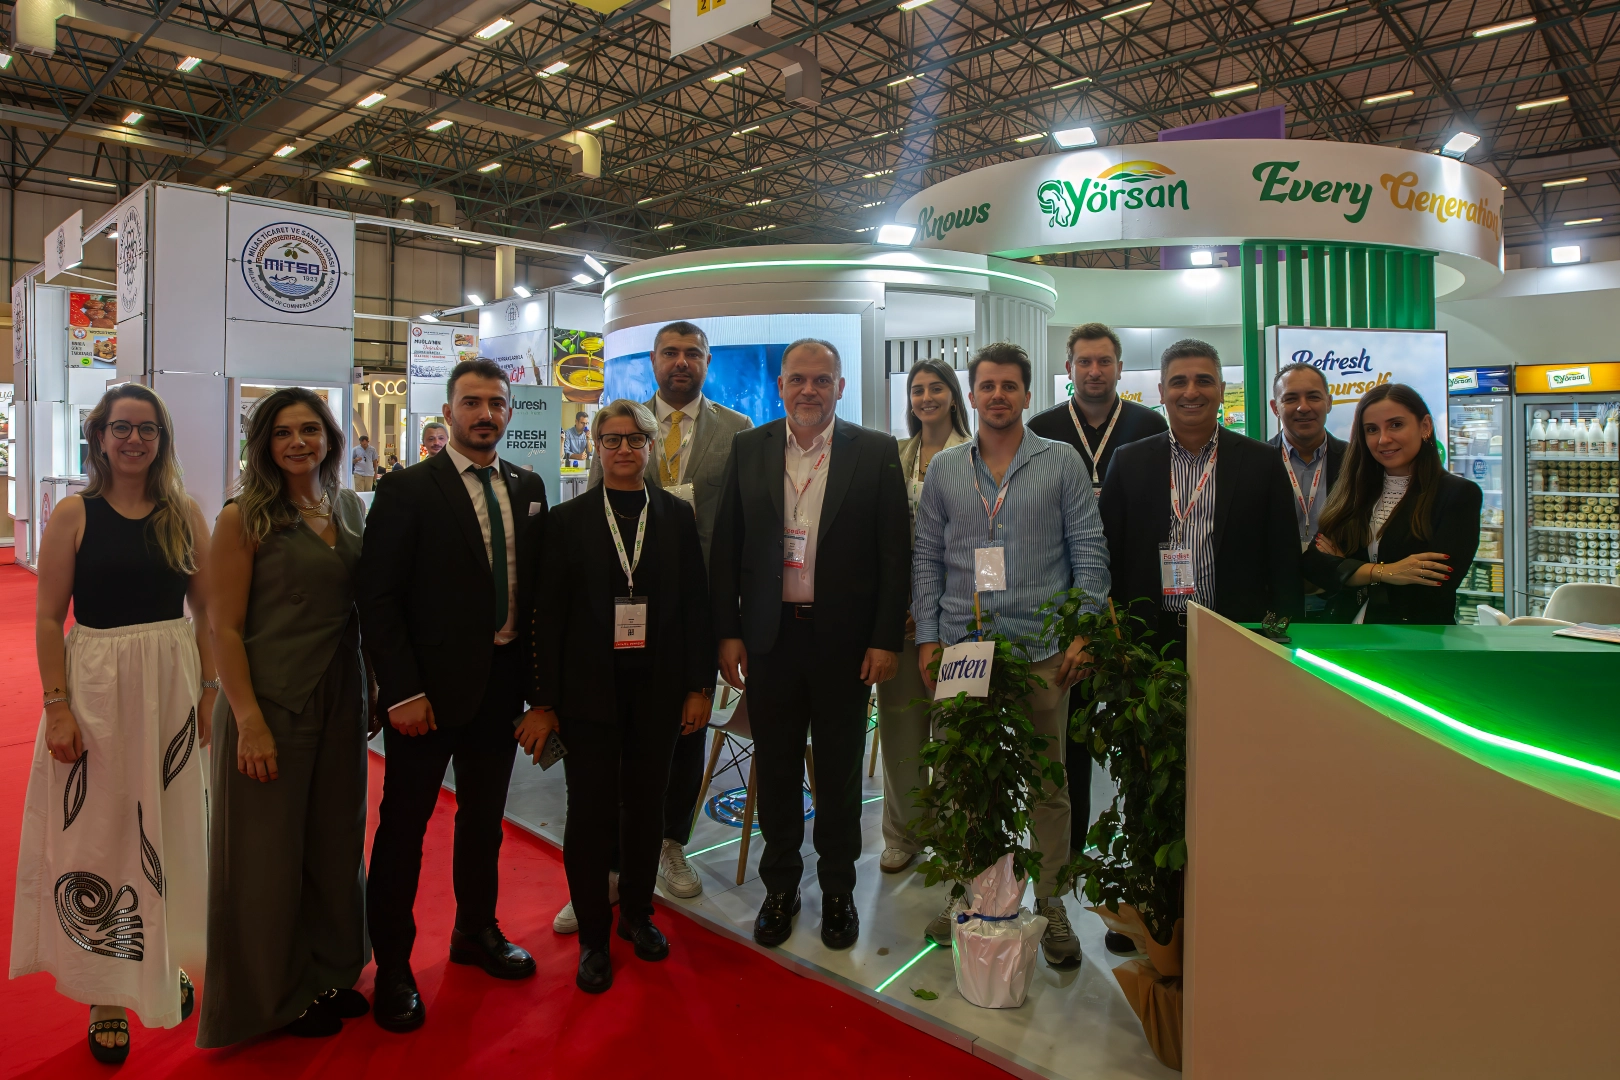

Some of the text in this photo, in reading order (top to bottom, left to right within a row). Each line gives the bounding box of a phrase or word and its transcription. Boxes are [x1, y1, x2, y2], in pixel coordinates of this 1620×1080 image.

[1063, 177, 1190, 228] Yörsan
[1252, 160, 1499, 242] Every Generation
[290, 227, 301, 235] VE
[917, 202, 991, 241] Knows
[1291, 348, 1374, 372] Refresh
[1328, 371, 1393, 396] ourself
[506, 430, 547, 440] FRESH
[506, 440, 547, 449] FROZEN
[938, 654, 988, 683] sarten
